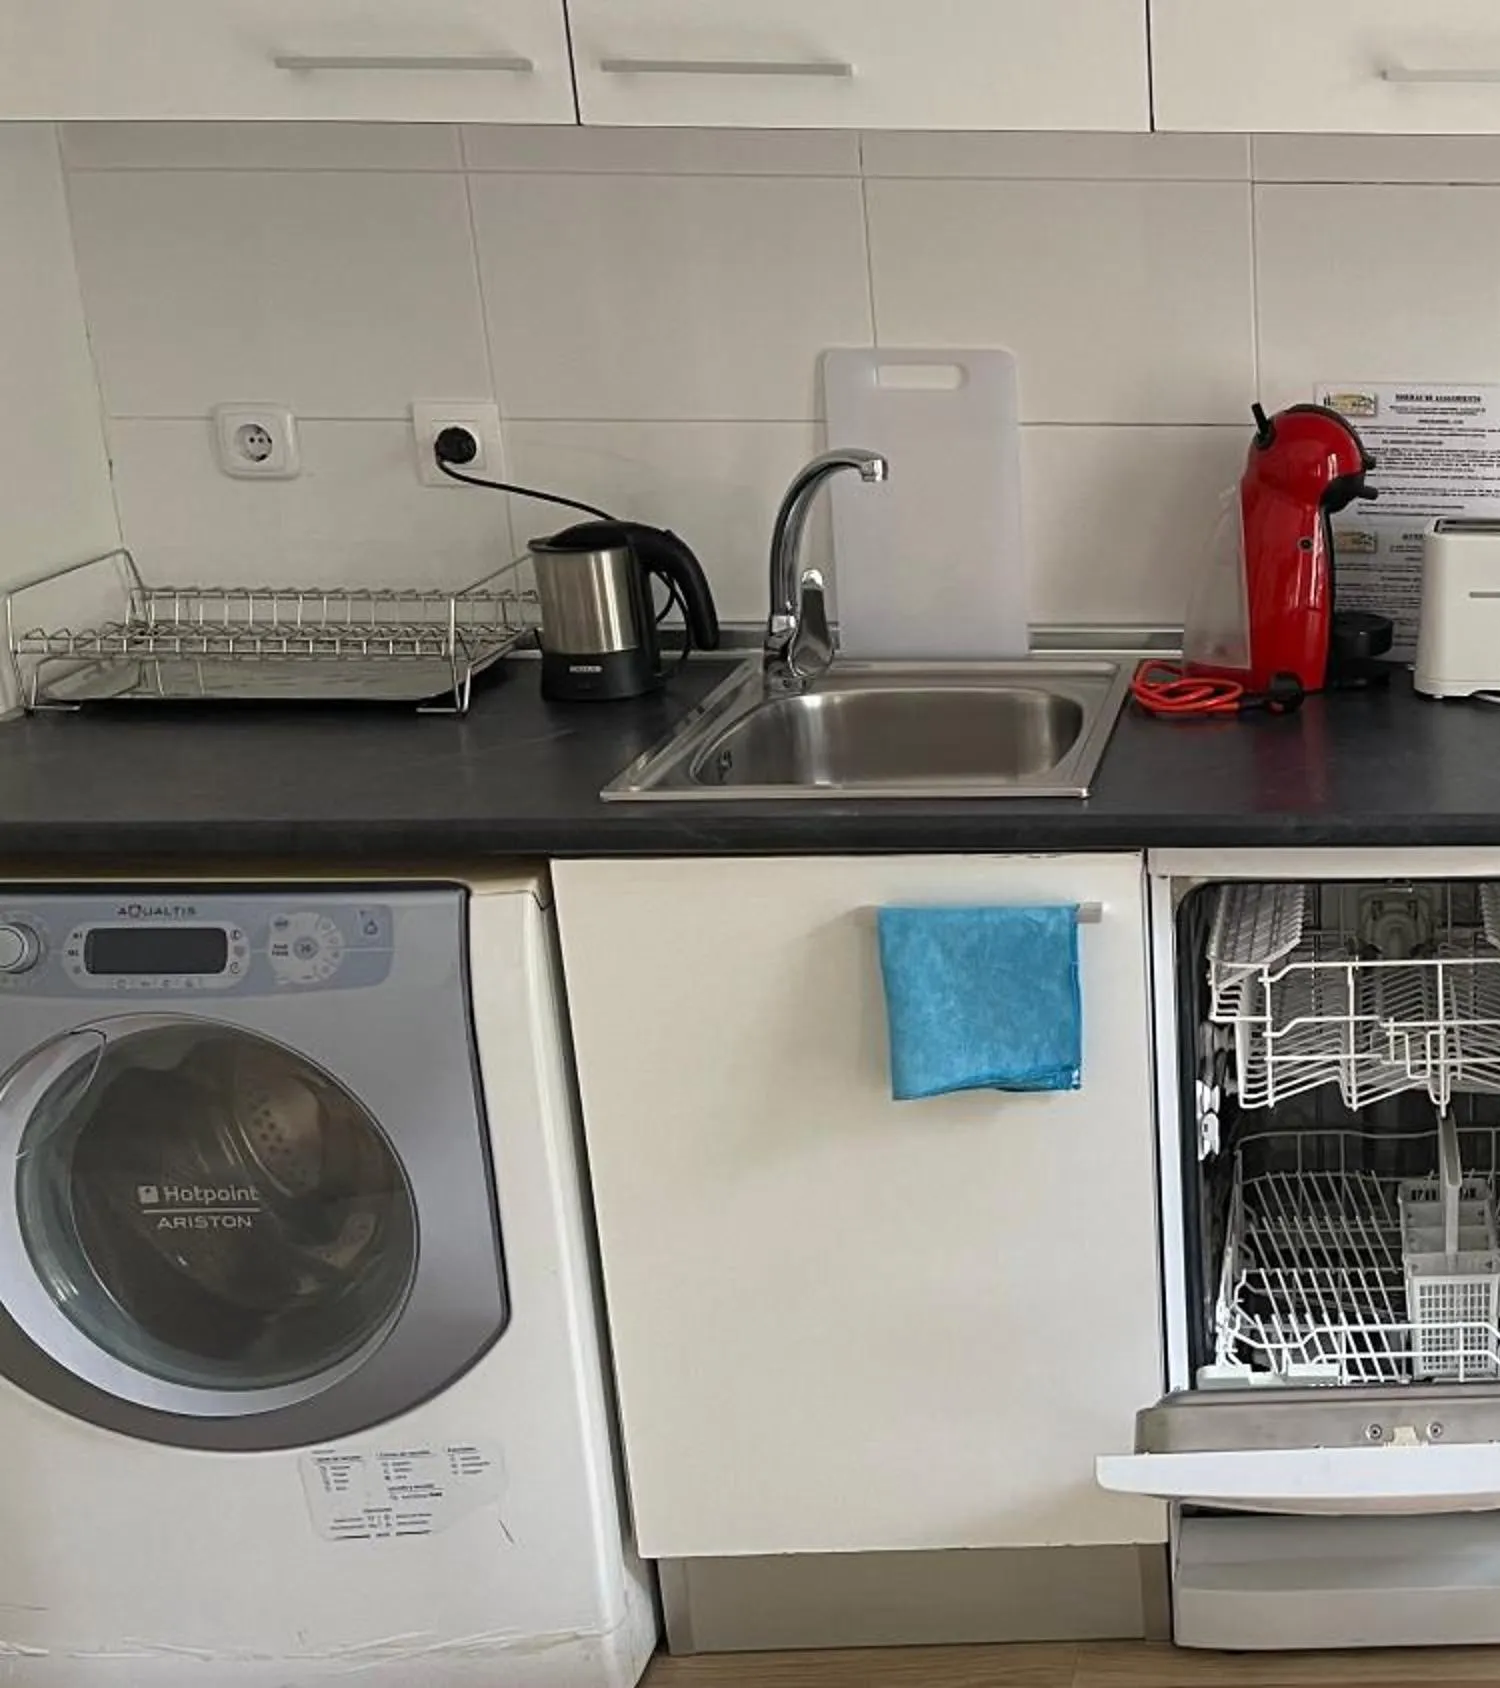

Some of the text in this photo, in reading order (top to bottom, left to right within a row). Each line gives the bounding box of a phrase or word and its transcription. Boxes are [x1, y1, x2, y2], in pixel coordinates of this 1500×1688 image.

[117, 903, 197, 919] AQUALTIS
[163, 1184, 260, 1205] Hotpoint
[158, 1215, 252, 1229] ARISTON
